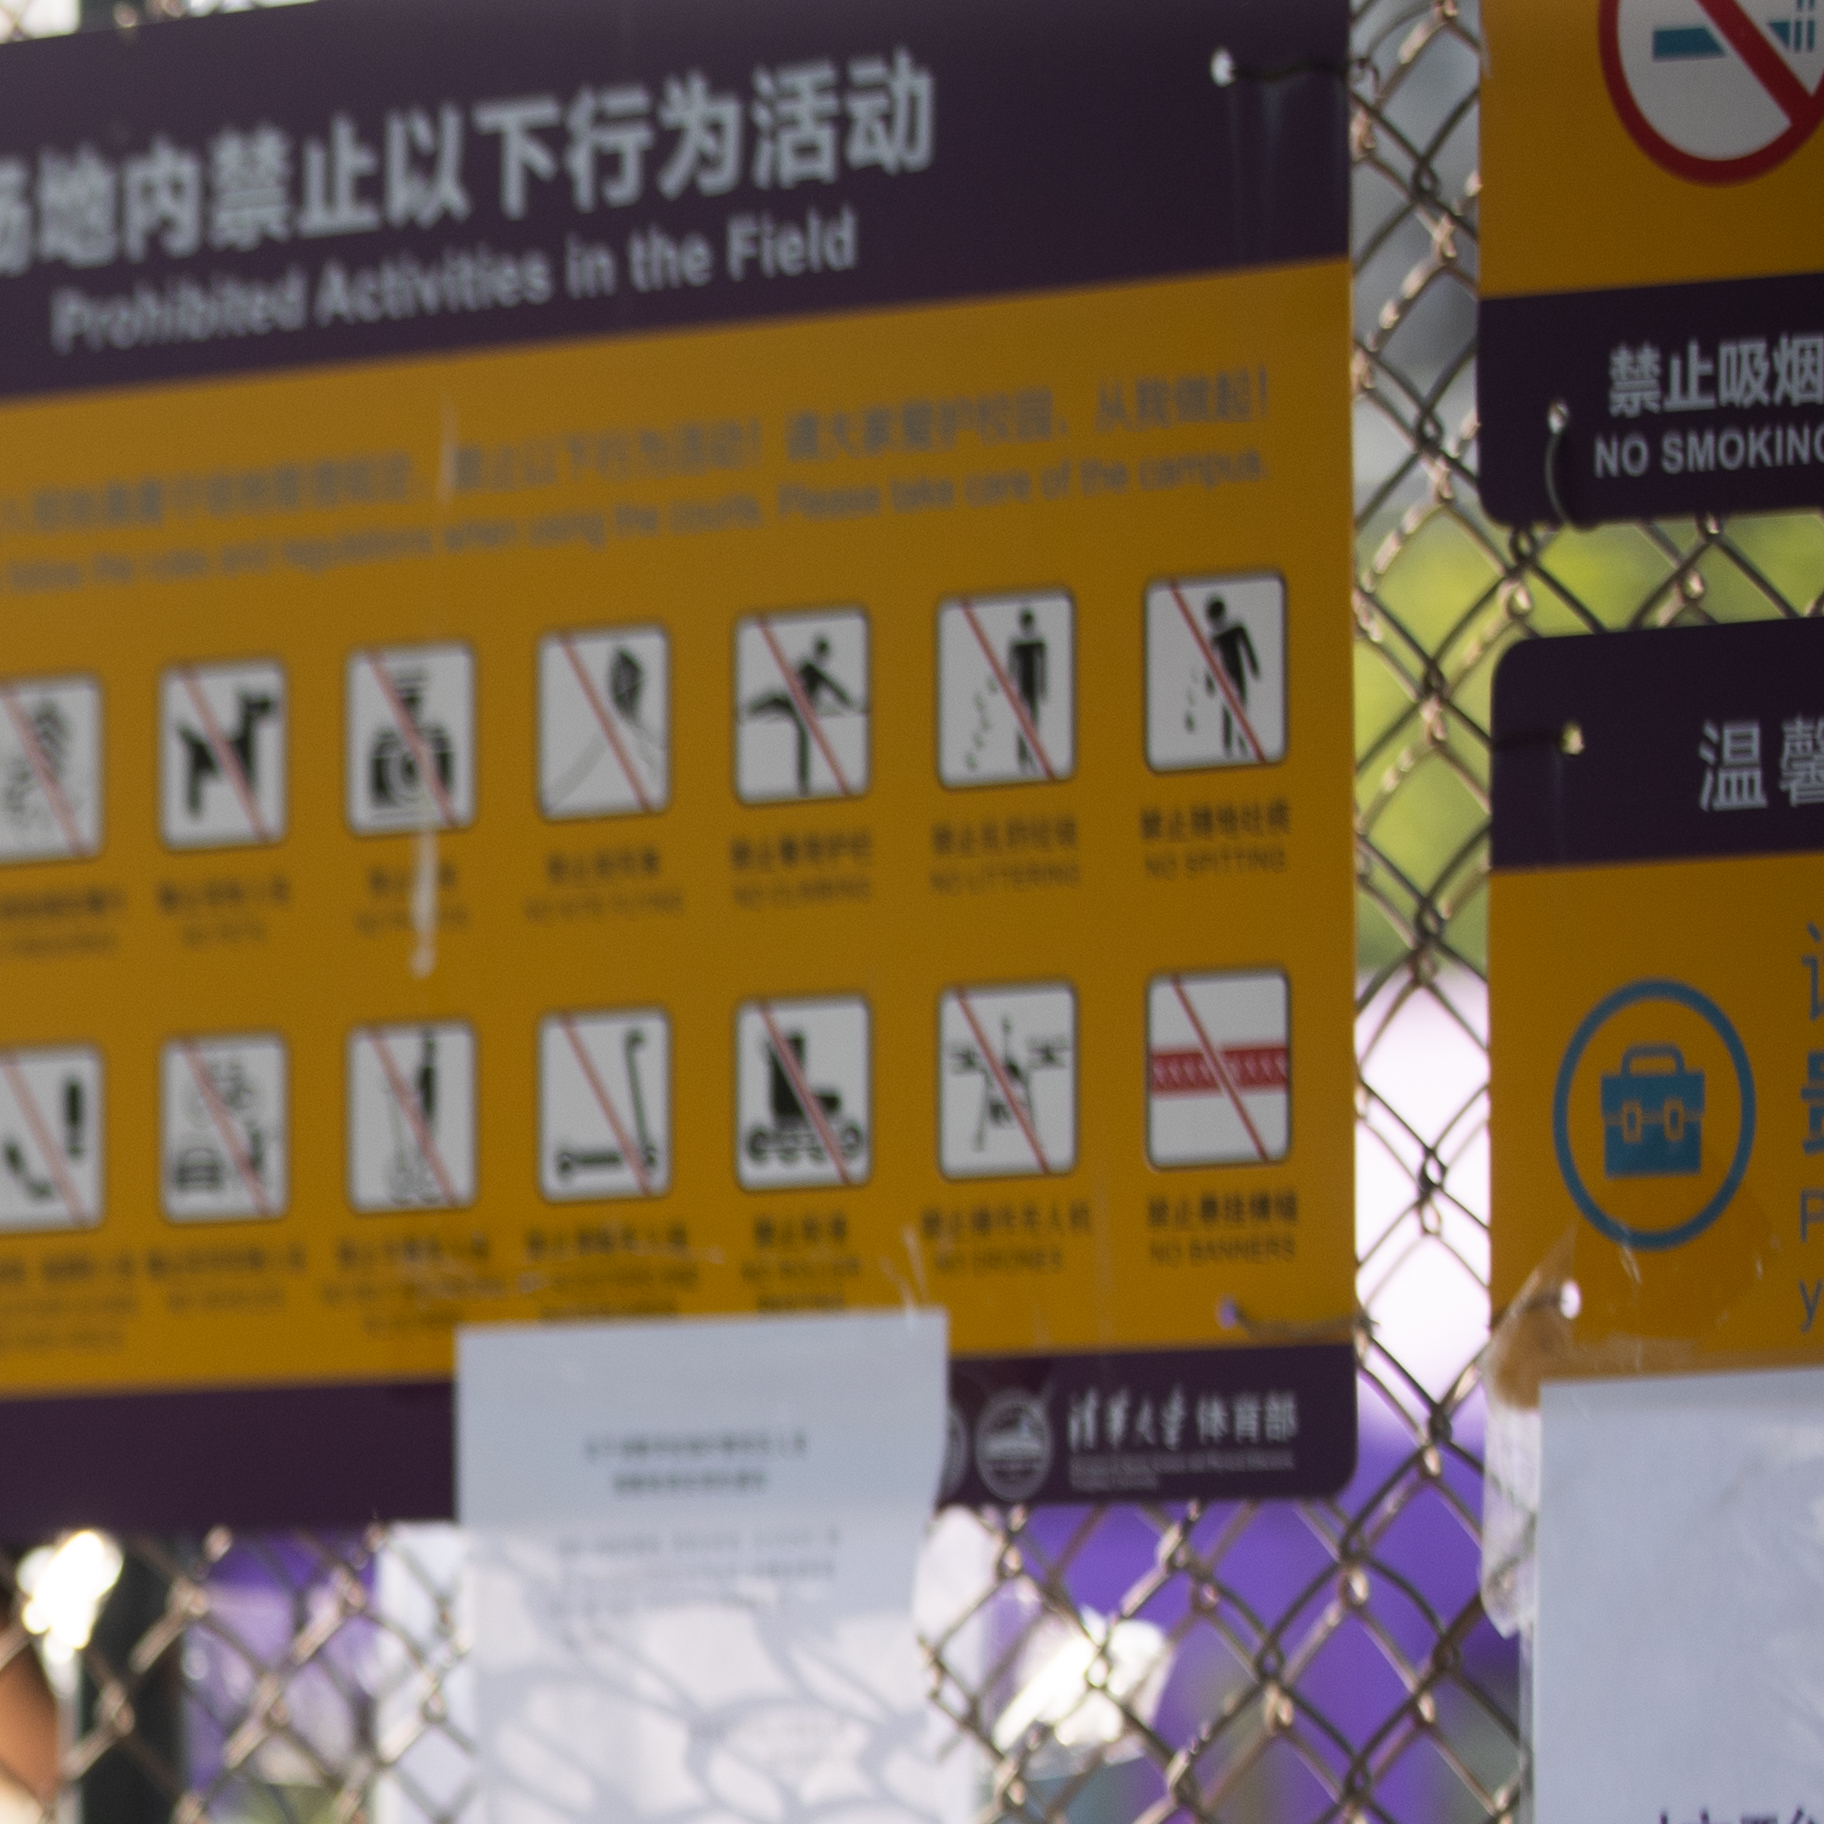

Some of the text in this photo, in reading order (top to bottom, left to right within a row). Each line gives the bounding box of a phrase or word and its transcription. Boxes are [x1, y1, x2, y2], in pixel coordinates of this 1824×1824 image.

[51, 206, 856, 353] Prohibited Activities in the Field
[1610, 333, 1824, 418] 禁止吸烟
[1595, 434, 1649, 478] NO
[1145, 843, 1287, 881] NO SPITTING
[1149, 1234, 1295, 1267] NO BANNERS
